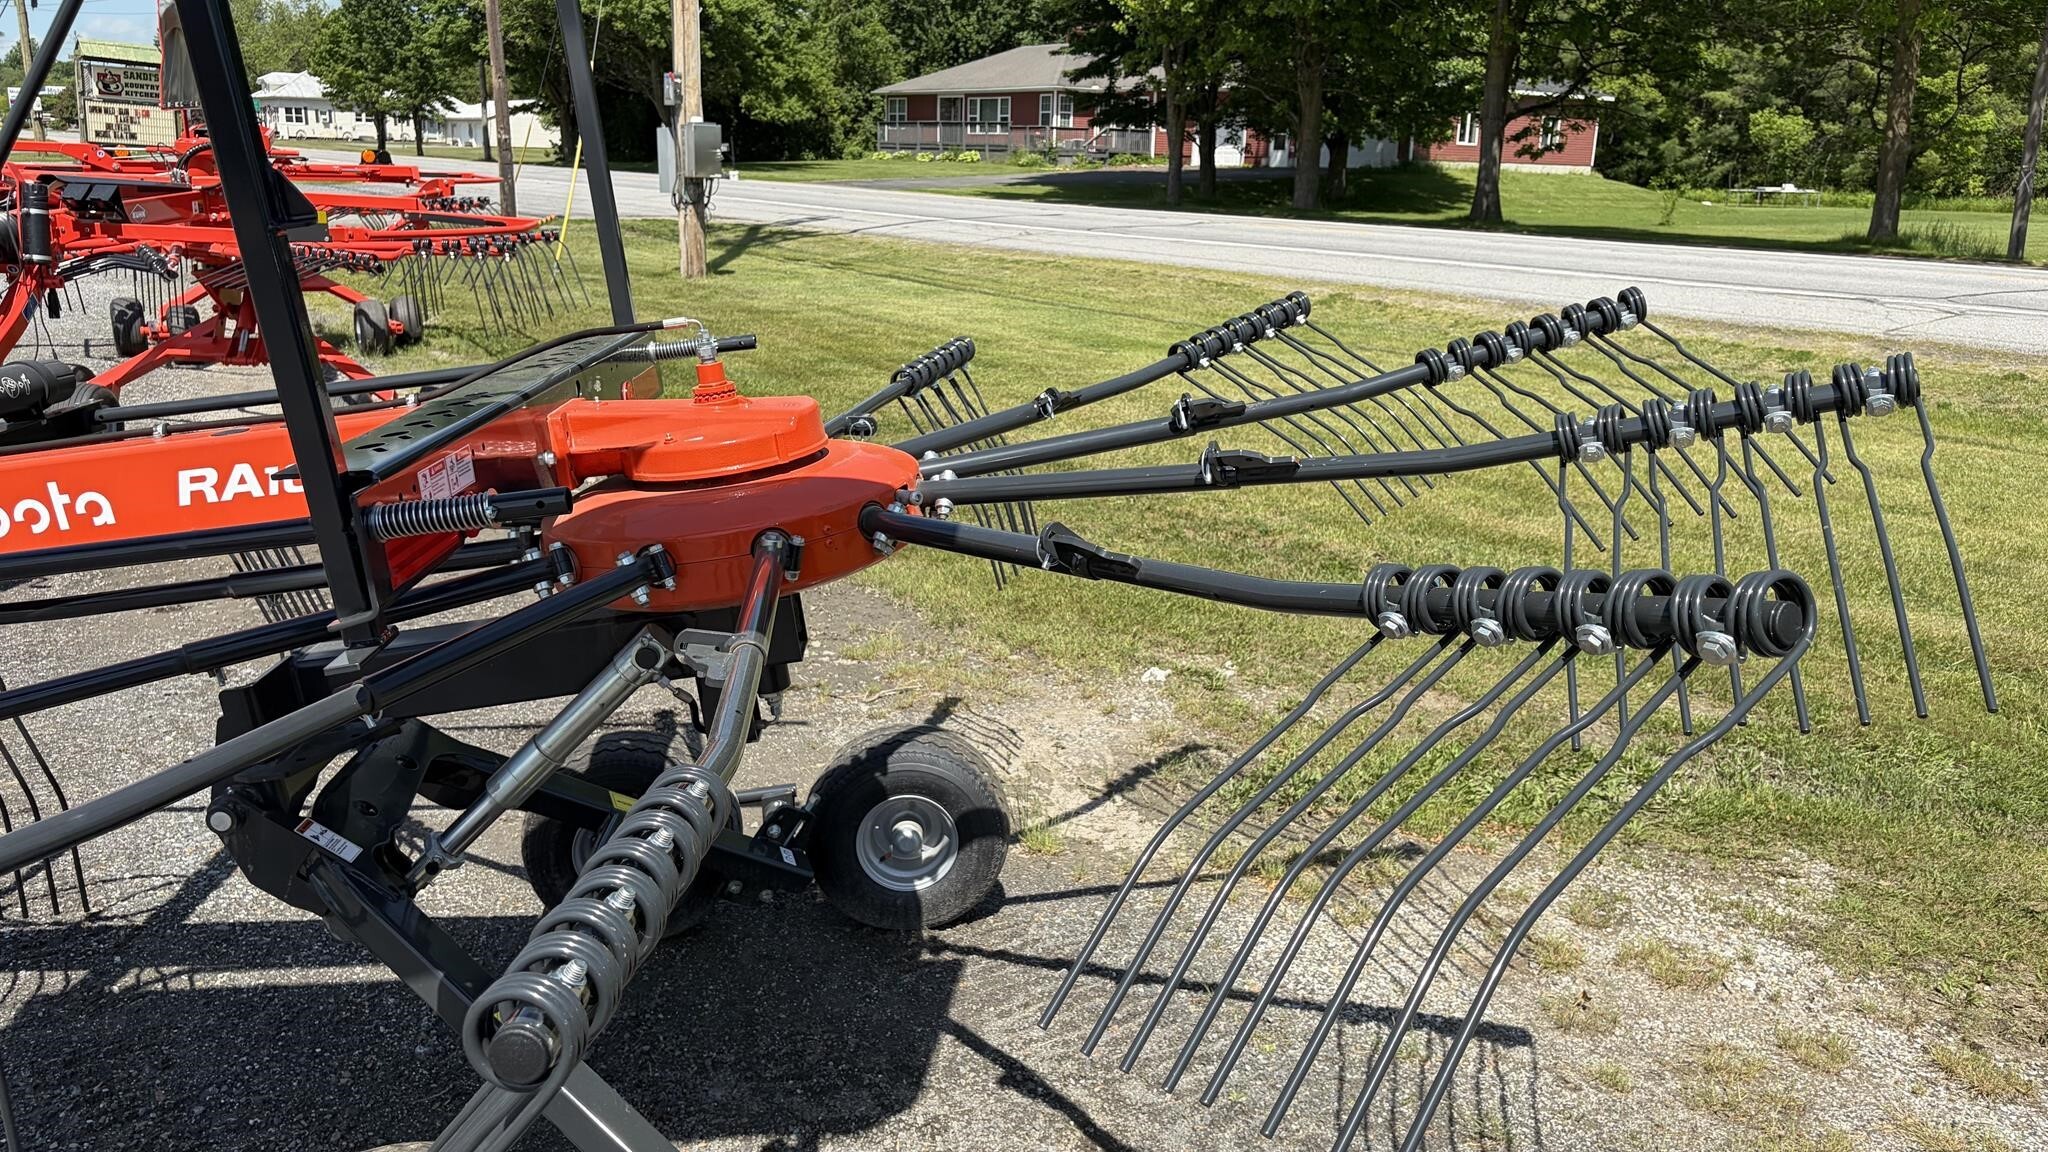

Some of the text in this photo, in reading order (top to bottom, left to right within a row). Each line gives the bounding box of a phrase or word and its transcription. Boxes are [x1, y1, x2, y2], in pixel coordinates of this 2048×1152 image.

[123, 70, 160, 82] SANDI'S
[124, 82, 160, 91] KOUNTRY
[125, 90, 160, 99] KITCHEN
